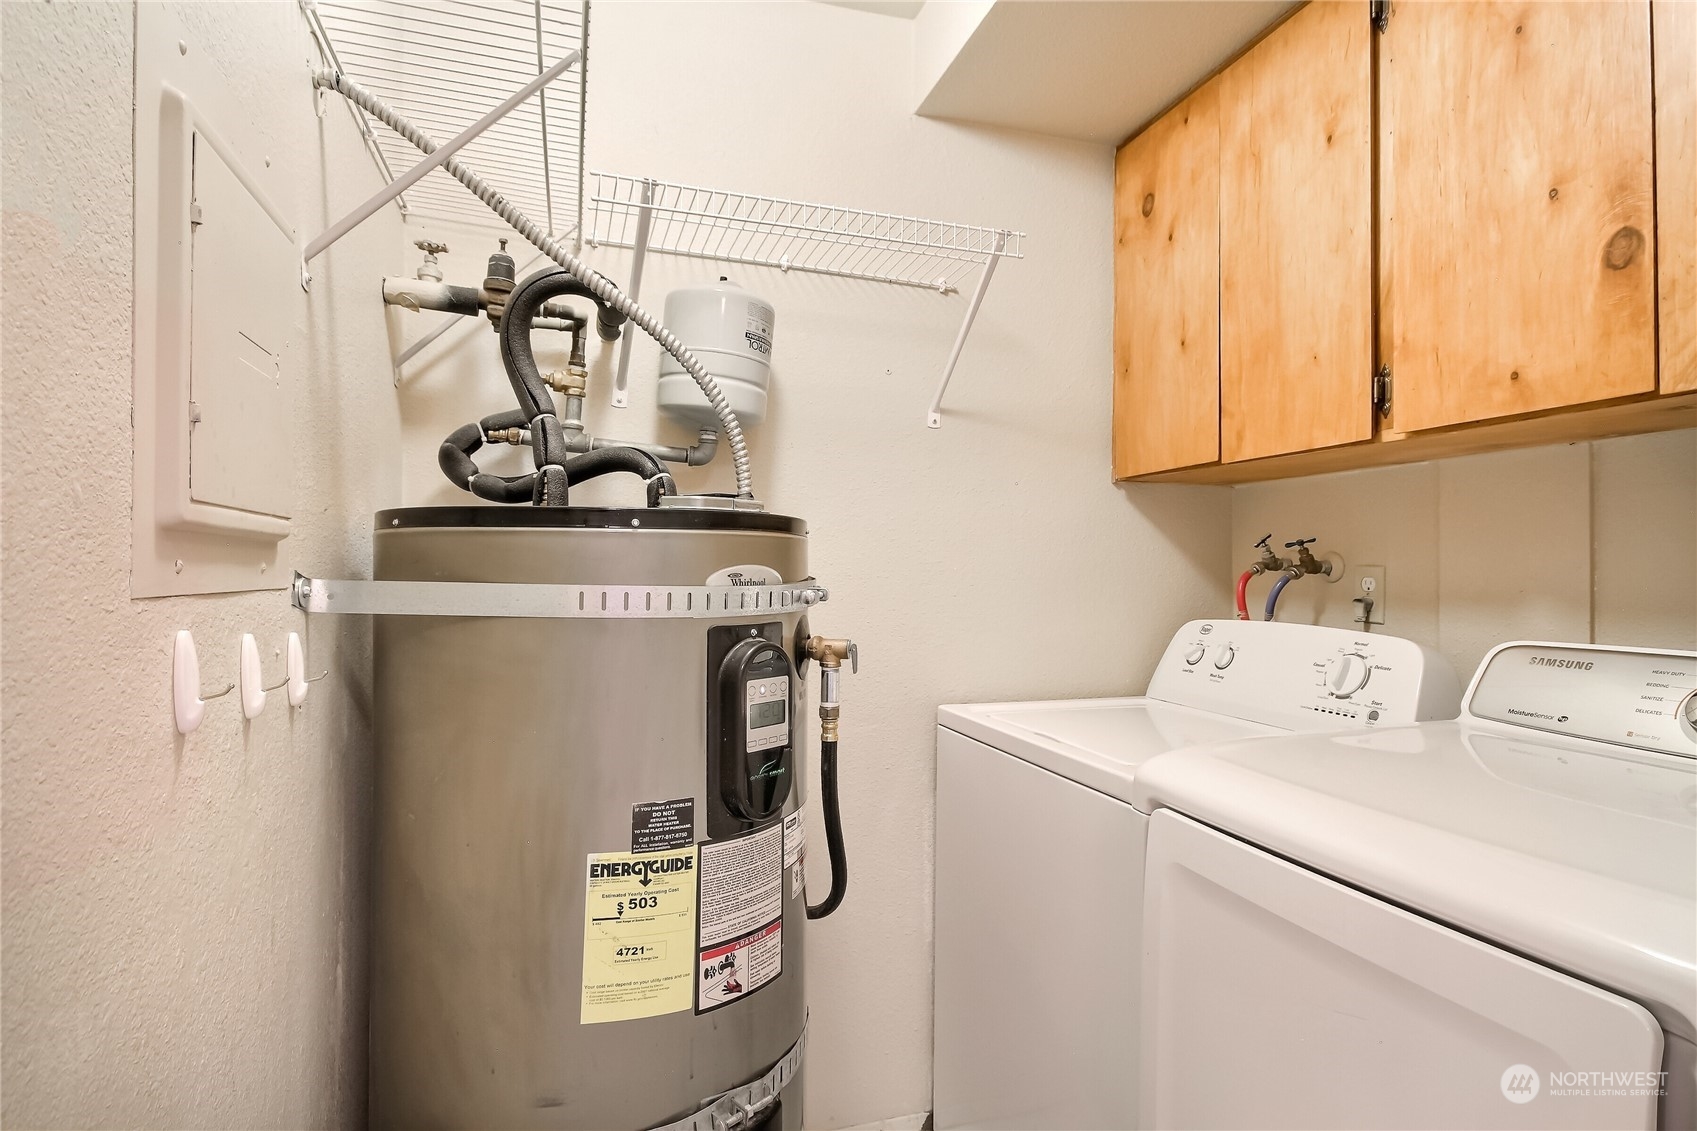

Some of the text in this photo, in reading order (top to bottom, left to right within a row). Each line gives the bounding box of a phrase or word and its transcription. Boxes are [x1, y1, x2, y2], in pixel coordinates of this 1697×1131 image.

[1529, 656, 1594, 671] SAMSUNG
[1508, 708, 1554, 720] MoistureSensor
[590, 856, 693, 878] ENERGYGUIDE
[616, 896, 658, 911] $ 503
[740, 930, 766, 946] DANGER
[616, 946, 645, 956] 4721
